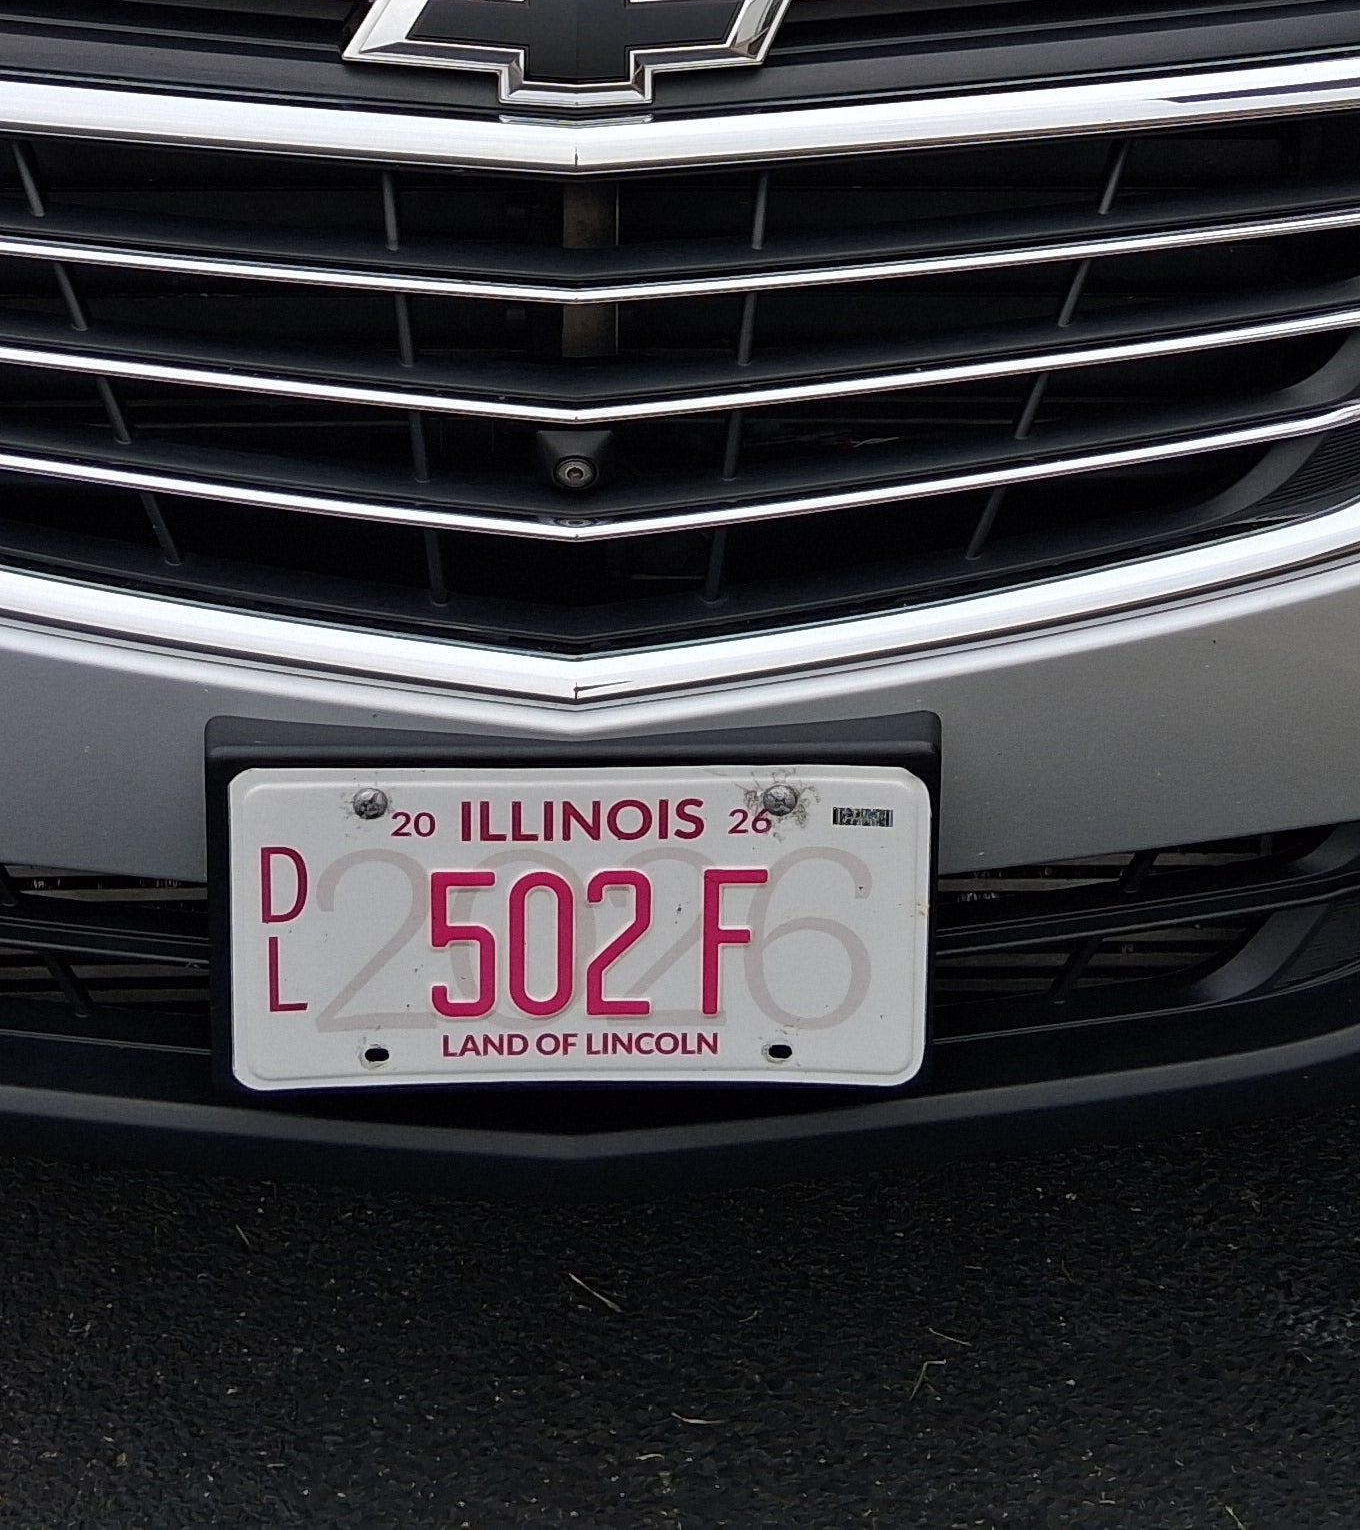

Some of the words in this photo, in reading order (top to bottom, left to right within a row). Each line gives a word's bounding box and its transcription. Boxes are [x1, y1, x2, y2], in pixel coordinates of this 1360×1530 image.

[391, 811, 436, 838] 20
[460, 798, 705, 842] ILLINOIS
[728, 808, 772, 835] 26
[430, 869, 652, 1018] 502
[702, 868, 769, 1016] F
[442, 1032, 529, 1058] LAND
[535, 1032, 578, 1057] OF
[586, 1031, 719, 1056] LINCOLN
